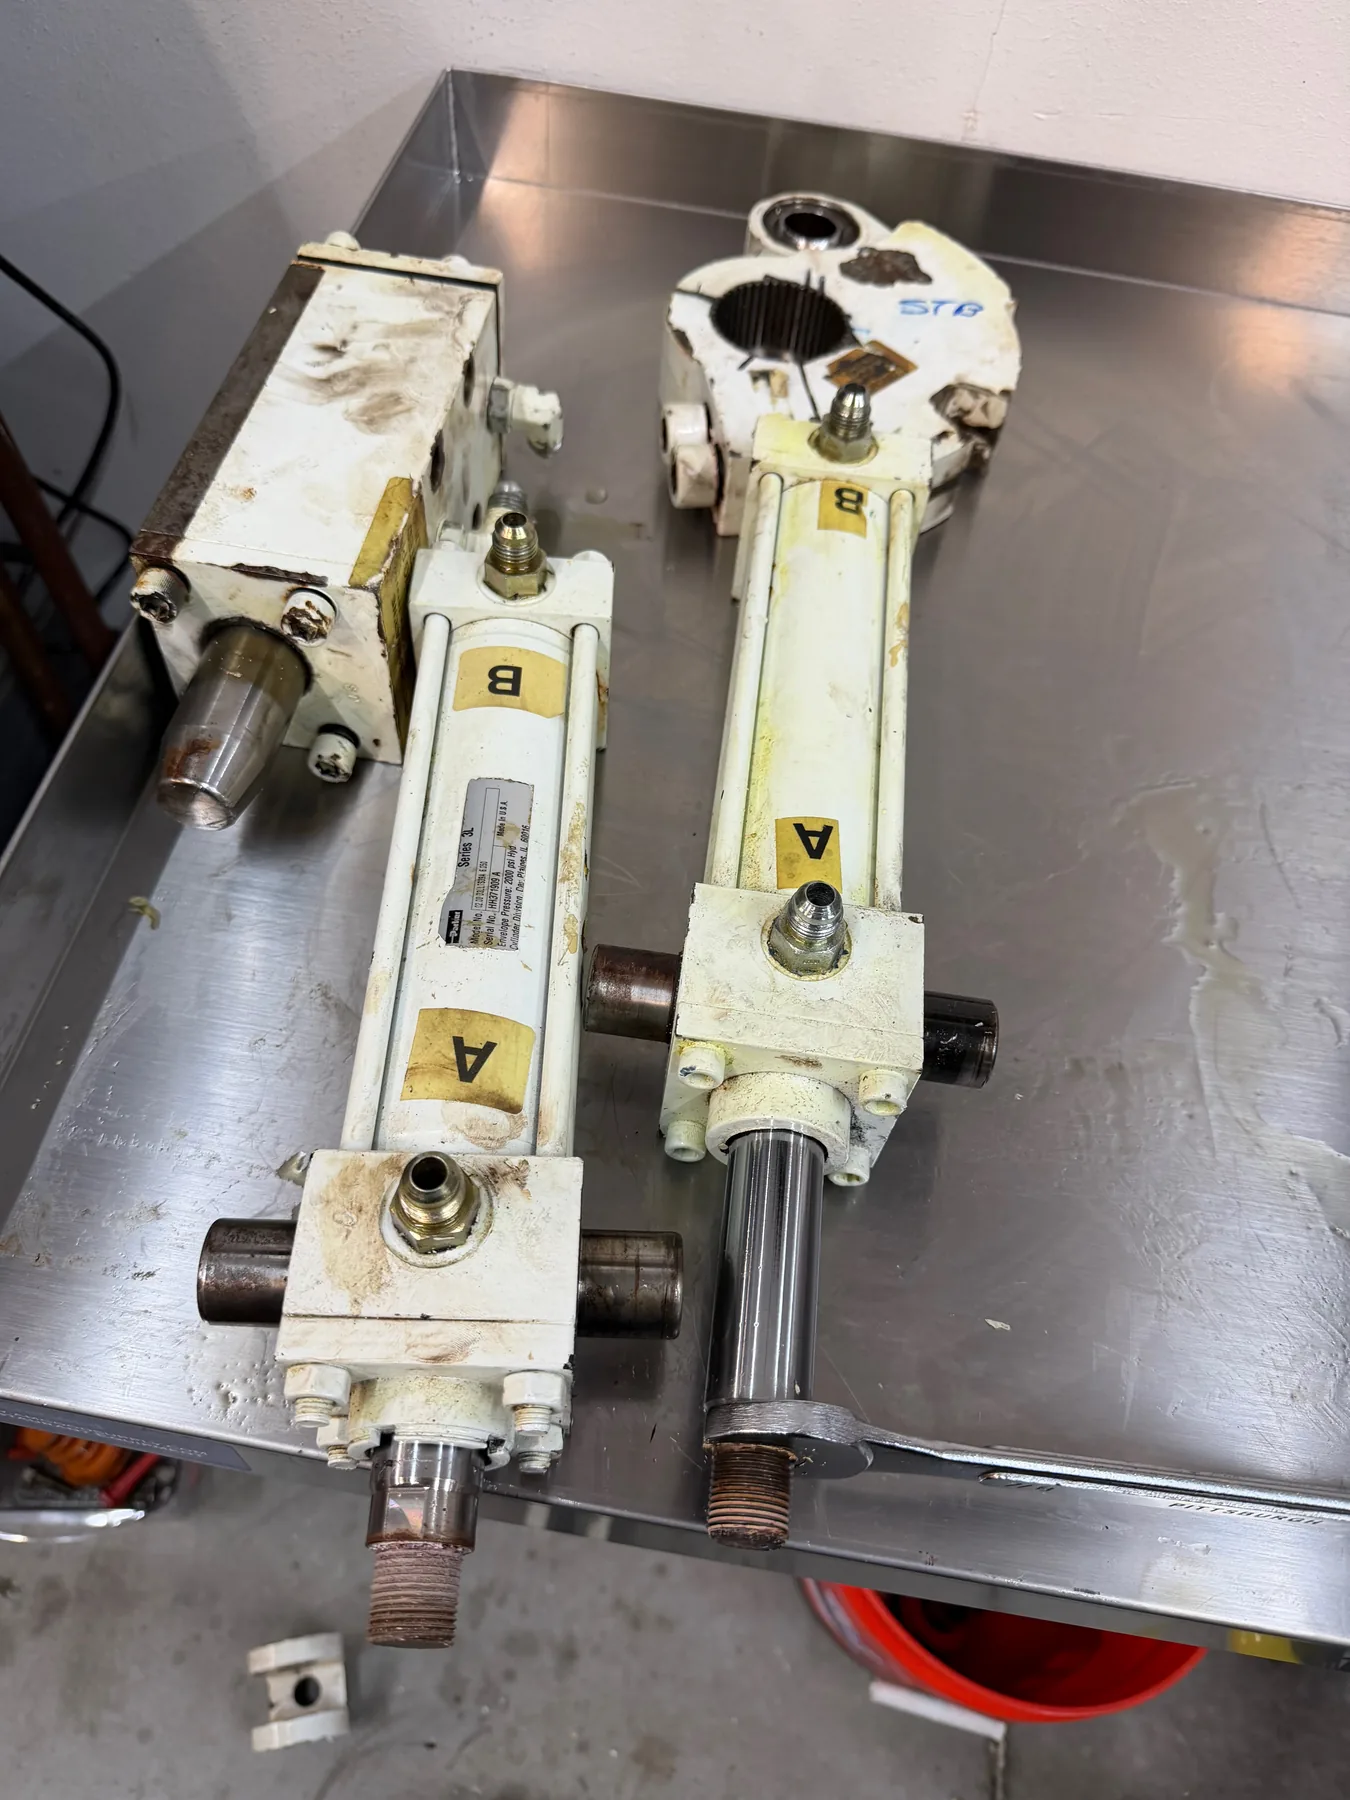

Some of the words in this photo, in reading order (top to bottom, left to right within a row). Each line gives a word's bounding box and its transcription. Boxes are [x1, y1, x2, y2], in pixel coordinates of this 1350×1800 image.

[834, 488, 864, 515] B
[488, 665, 522, 697] B
[461, 827, 474, 838] 3L
[497, 823, 505, 836] Made
[793, 823, 833, 860] A
[457, 842, 472, 868] Series
[507, 858, 516, 869] psi
[504, 869, 514, 885] 2000
[488, 878, 500, 909] HH371909
[501, 886, 512, 917] Pressure:
[473, 911, 483, 922] No.
[486, 913, 496, 924] No.
[470, 924, 481, 944] Model
[484, 926, 494, 945] Serial
[497, 918, 509, 947] Envelope
[452, 1036, 498, 1083] A
[1168, 1502, 1323, 1525] PITTSBURGH
